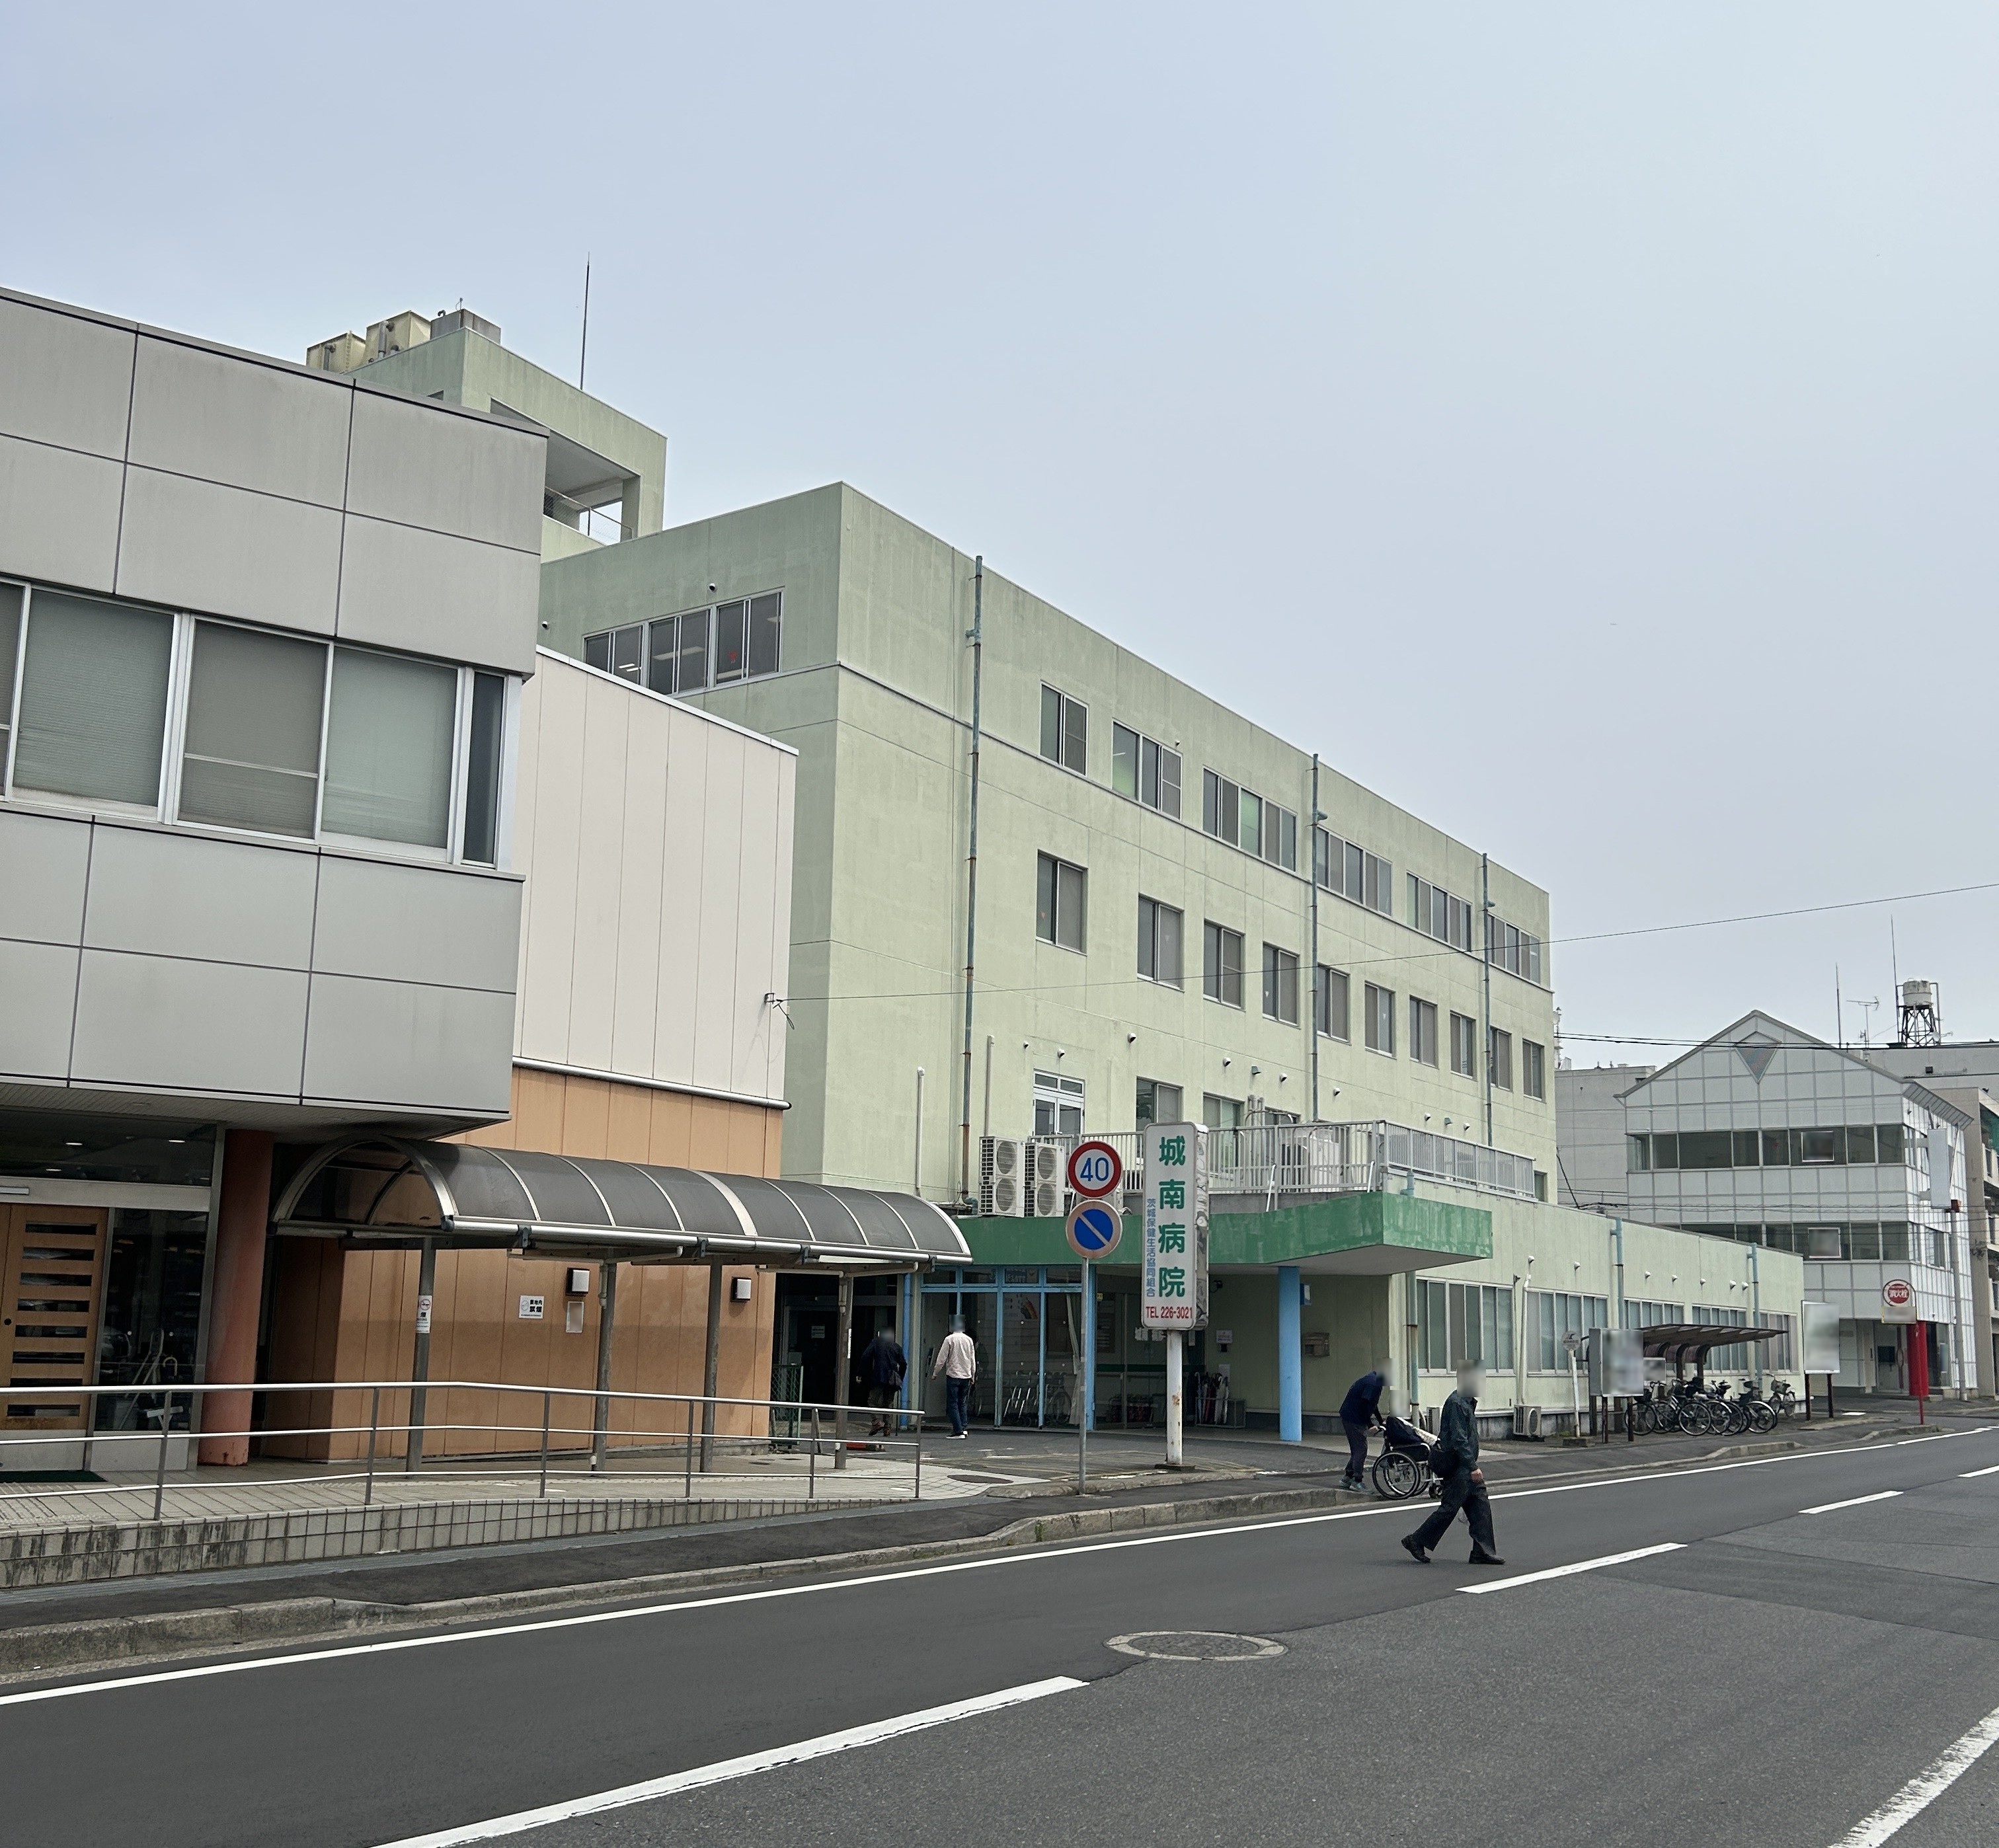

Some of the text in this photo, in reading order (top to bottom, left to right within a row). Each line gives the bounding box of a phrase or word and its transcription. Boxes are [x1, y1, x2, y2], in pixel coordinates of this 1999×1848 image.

[1080, 1157, 1109, 1182] 40
[1146, 1198, 1156, 1297] 茨城保健生活協同組合
[1158, 1135, 1186, 1298] 城南病院
[1146, 1306, 1193, 1319] TEL 226-3021
